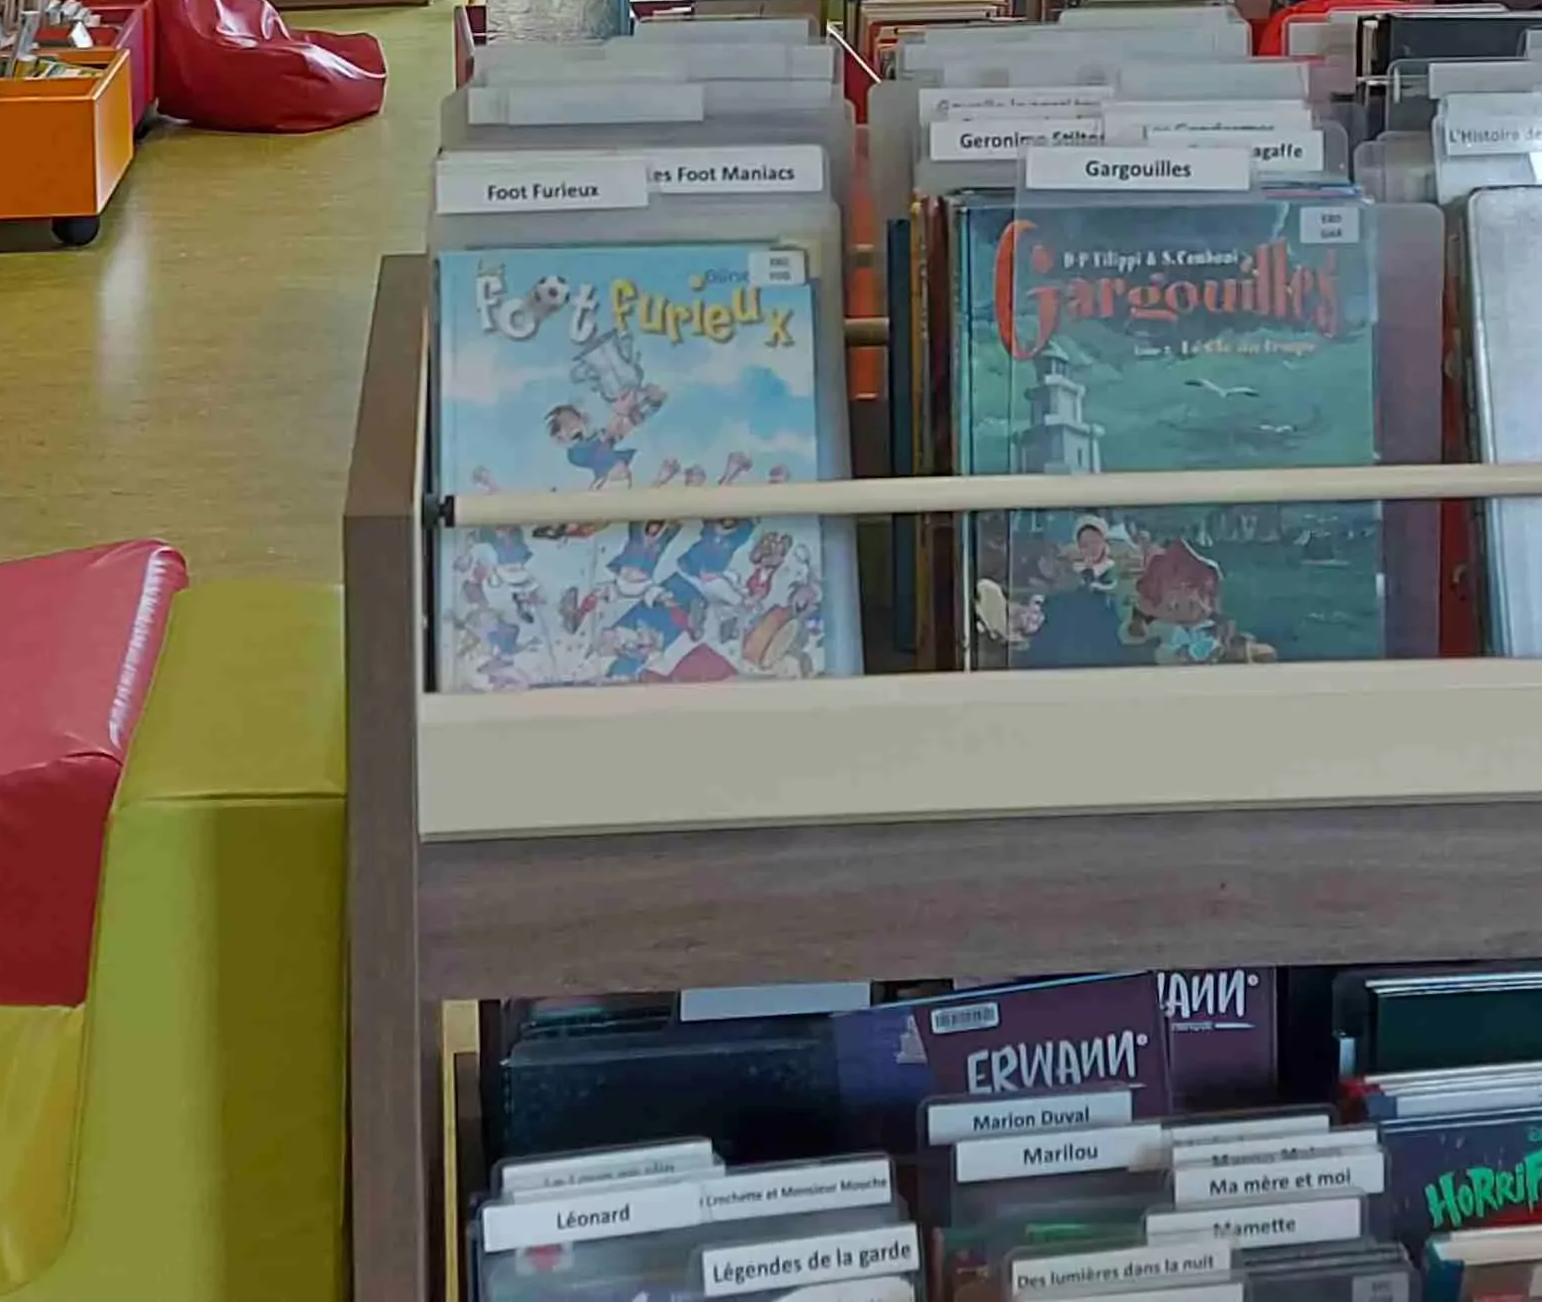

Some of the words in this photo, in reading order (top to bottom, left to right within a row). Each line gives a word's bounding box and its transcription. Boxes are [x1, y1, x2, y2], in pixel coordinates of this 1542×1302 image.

[1448, 126, 1519, 144] L'Histoire
[1253, 143, 1304, 161] agaffe
[677, 166, 716, 183] Foot
[722, 165, 795, 182] Maniacs
[1085, 159, 1192, 180] Gargouilles
[487, 184, 527, 201] Foot
[532, 181, 599, 200] Furieux
[995, 219, 1339, 361] Gargouilles
[966, 1030, 1137, 1094] ERWANN
[972, 1109, 1037, 1133] Marion
[1041, 1105, 1091, 1127] Duval
[1022, 1142, 1100, 1166] Marilou
[781, 1182, 837, 1198] Monsieur
[1209, 1178, 1239, 1196] Ma
[1244, 1171, 1290, 1195] mère
[1295, 1171, 1314, 1189] et
[1318, 1167, 1352, 1187] moi
[556, 1204, 631, 1230] Léonard
[1212, 1216, 1297, 1239] Mamette
[712, 1253, 803, 1285] Légendes
[807, 1250, 832, 1271] de
[836, 1247, 853, 1268] la
[859, 1241, 912, 1270] garde
[1017, 1272, 1046, 1290] Des
[1049, 1261, 1120, 1288] lumières
[1123, 1259, 1160, 1278] dans
[1163, 1256, 1180, 1274] la
[1183, 1254, 1215, 1272] nuit
